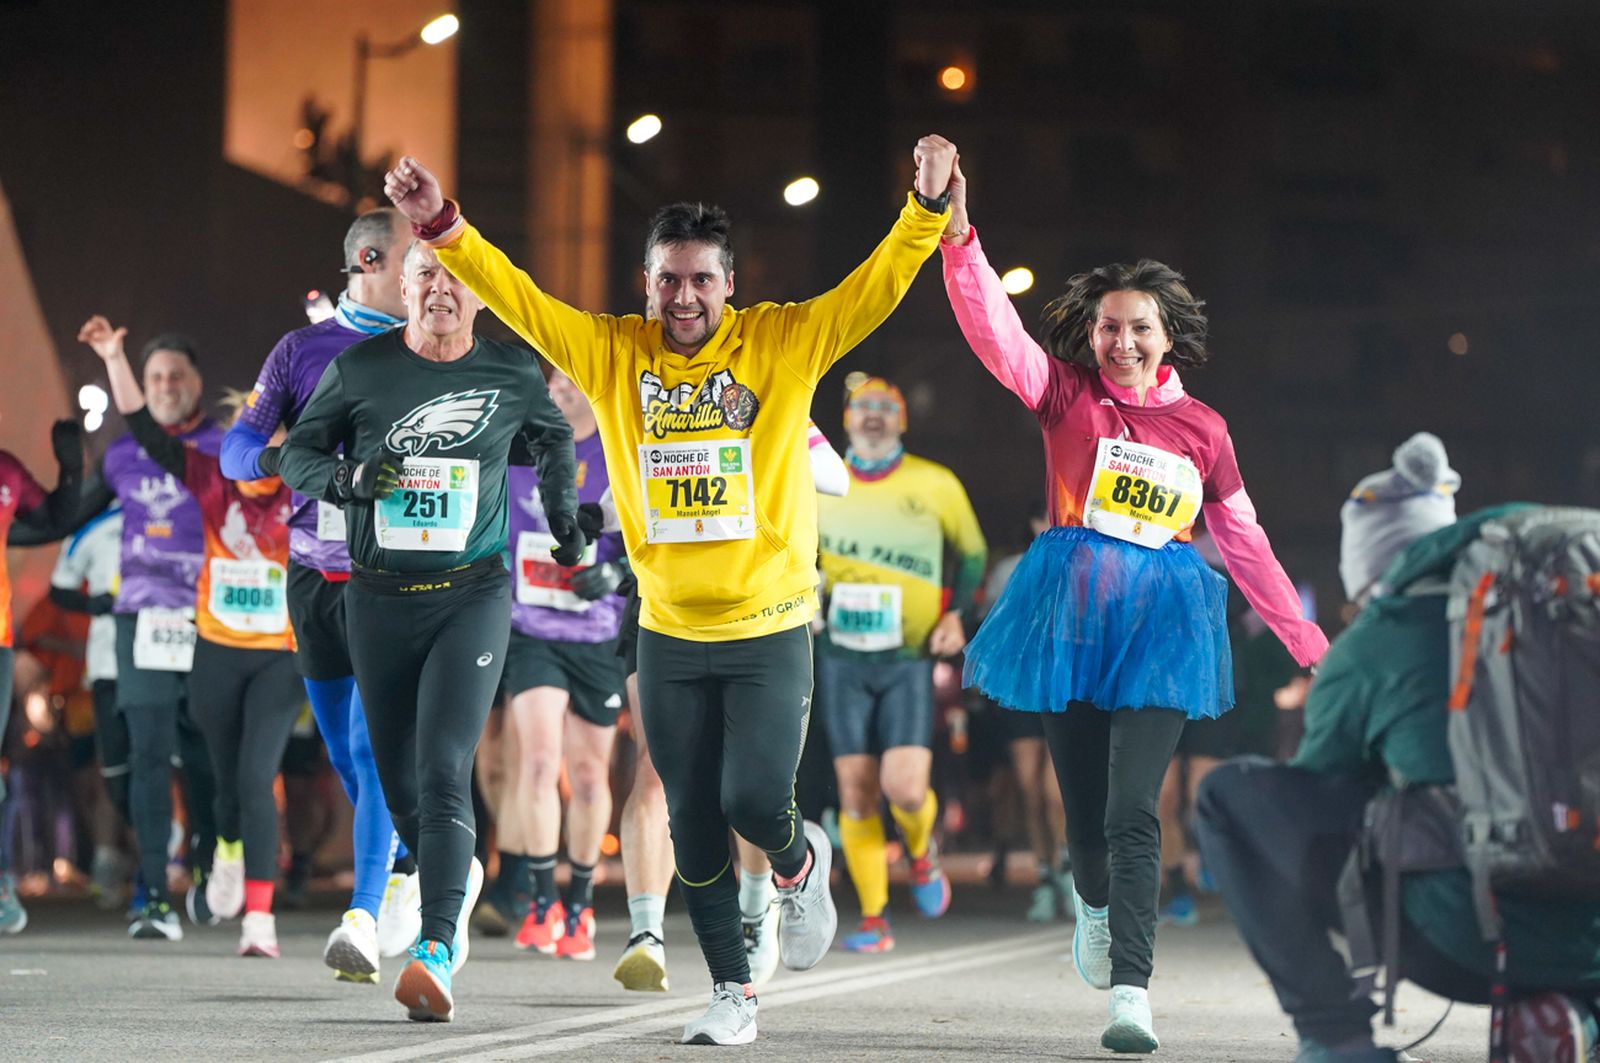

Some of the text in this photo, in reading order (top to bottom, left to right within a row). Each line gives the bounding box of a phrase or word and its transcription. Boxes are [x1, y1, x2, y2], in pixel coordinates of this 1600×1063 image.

[644, 400, 723, 437] Amarilla
[664, 454, 695, 463] NOCHE
[697, 452, 710, 462] DE
[1123, 452, 1155, 467] NOCHE
[428, 468, 441, 478] DE
[653, 465, 673, 477] SAN
[675, 463, 711, 476] ANTÓN
[1108, 460, 1131, 474] SAN
[666, 476, 728, 508] 7142
[1111, 474, 1182, 518] 8367
[402, 490, 449, 519] 251
[676, 509, 700, 517] Manuel
[761, 606, 774, 618] TU
